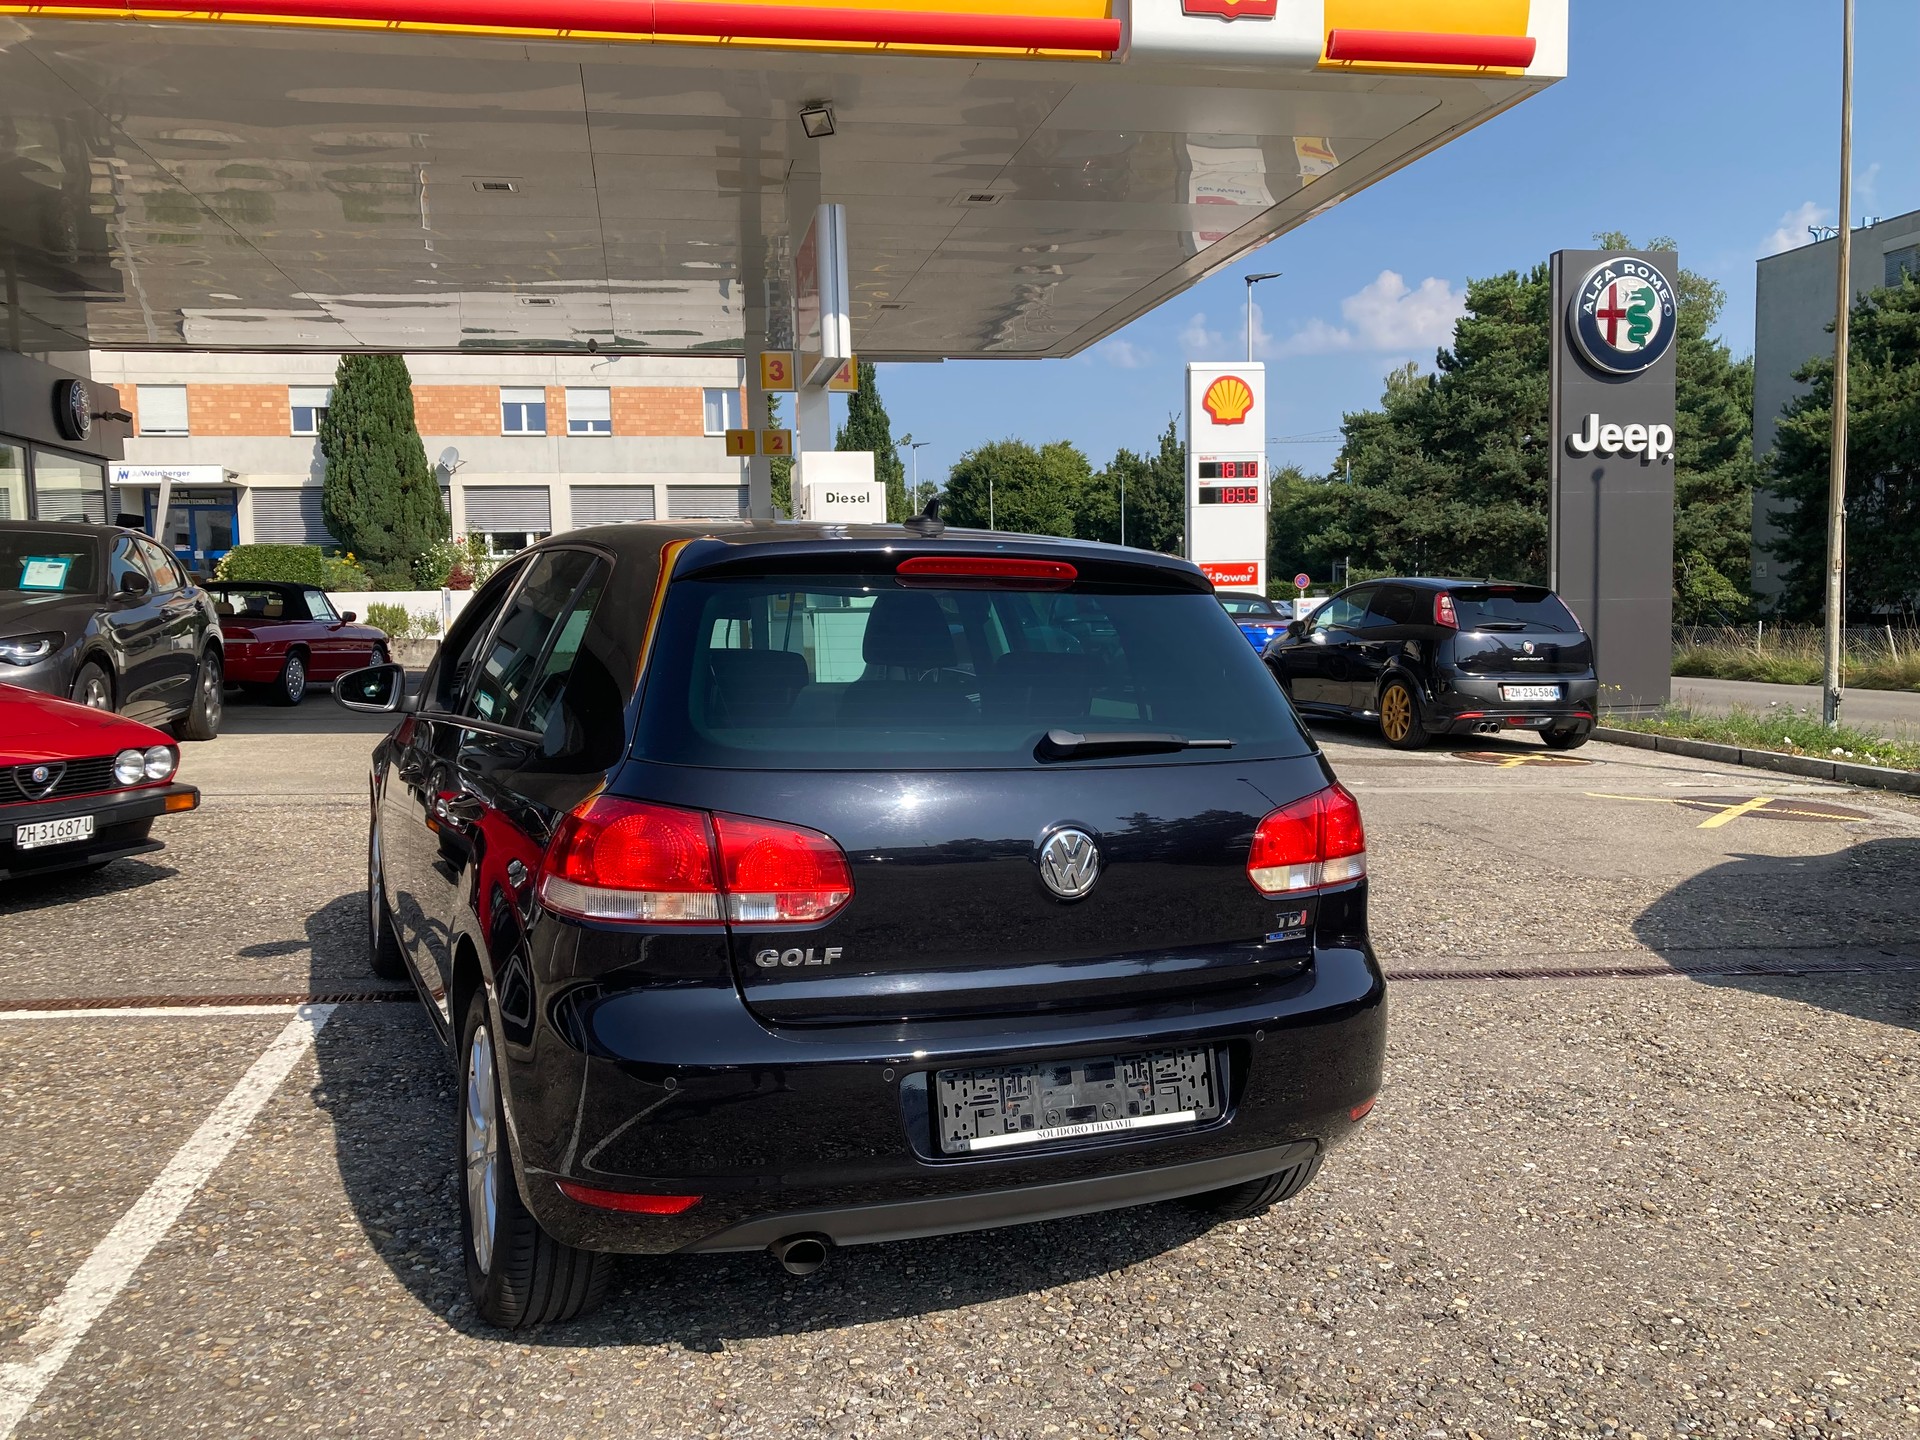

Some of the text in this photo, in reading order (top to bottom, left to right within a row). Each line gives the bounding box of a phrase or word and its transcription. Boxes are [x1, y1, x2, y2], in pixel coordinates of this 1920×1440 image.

[1582, 263, 1674, 317] ALFA ROMEO
[769, 360, 785, 381] 3
[835, 363, 851, 383] 4
[737, 436, 744, 450] 1
[772, 436, 783, 450] 2
[1572, 413, 1674, 460] Jeep
[825, 491, 871, 505] Diesel
[1221, 487, 1257, 504] 189.9
[1276, 910, 1307, 928] TDI
[755, 947, 843, 968] GOLF
[1037, 1124, 1089, 1139] SOLIDORO
